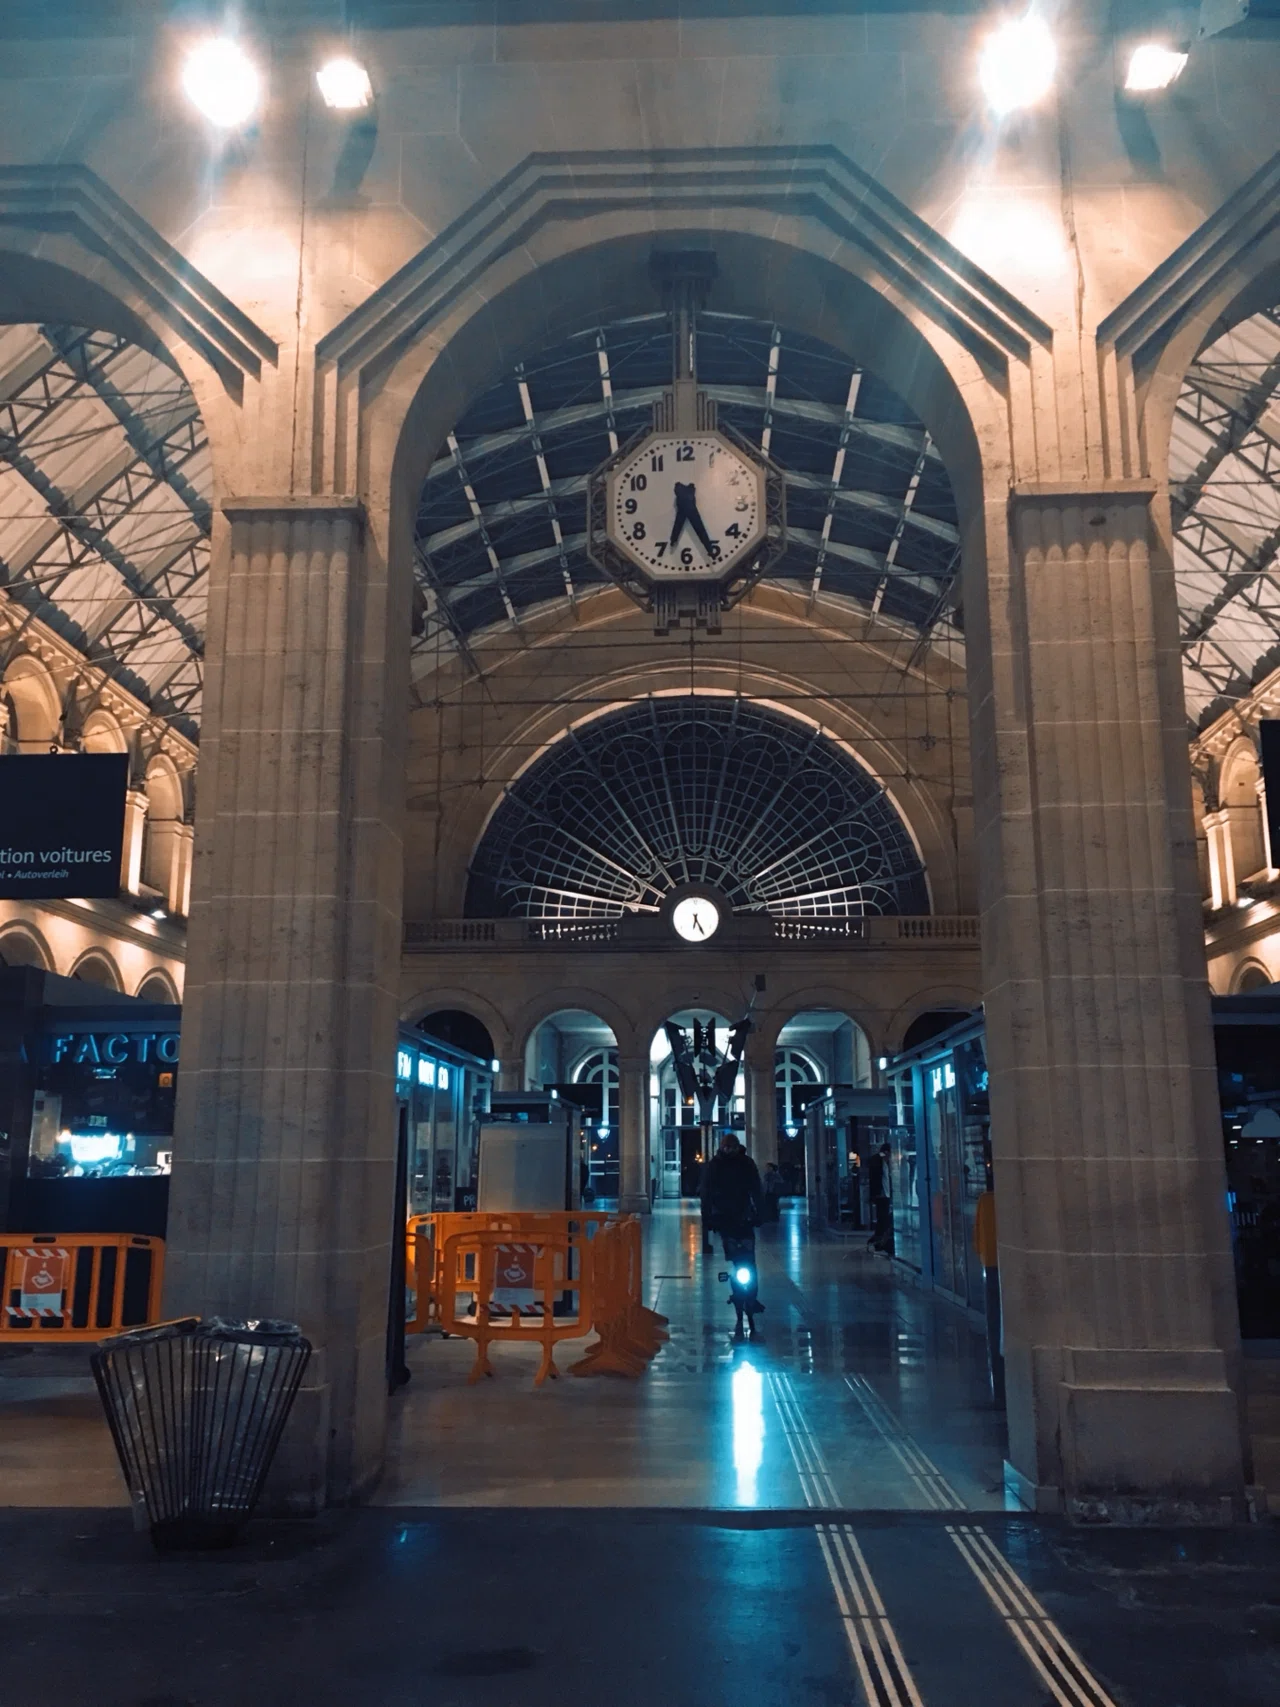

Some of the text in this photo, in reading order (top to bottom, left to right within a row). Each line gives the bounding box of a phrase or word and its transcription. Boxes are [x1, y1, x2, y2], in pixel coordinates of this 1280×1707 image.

[676, 446, 695, 462] 12
[651, 455, 664, 472] 11
[630, 474, 647, 491] 10
[625, 499, 638, 515] 9
[632, 522, 646, 540] 8
[725, 523, 741, 539] 4
[654, 542, 668, 558] 7
[680, 548, 693, 564] 6
[0, 847, 112, 864] tion voitures
[14, 869, 69, 879] Autoverleih
